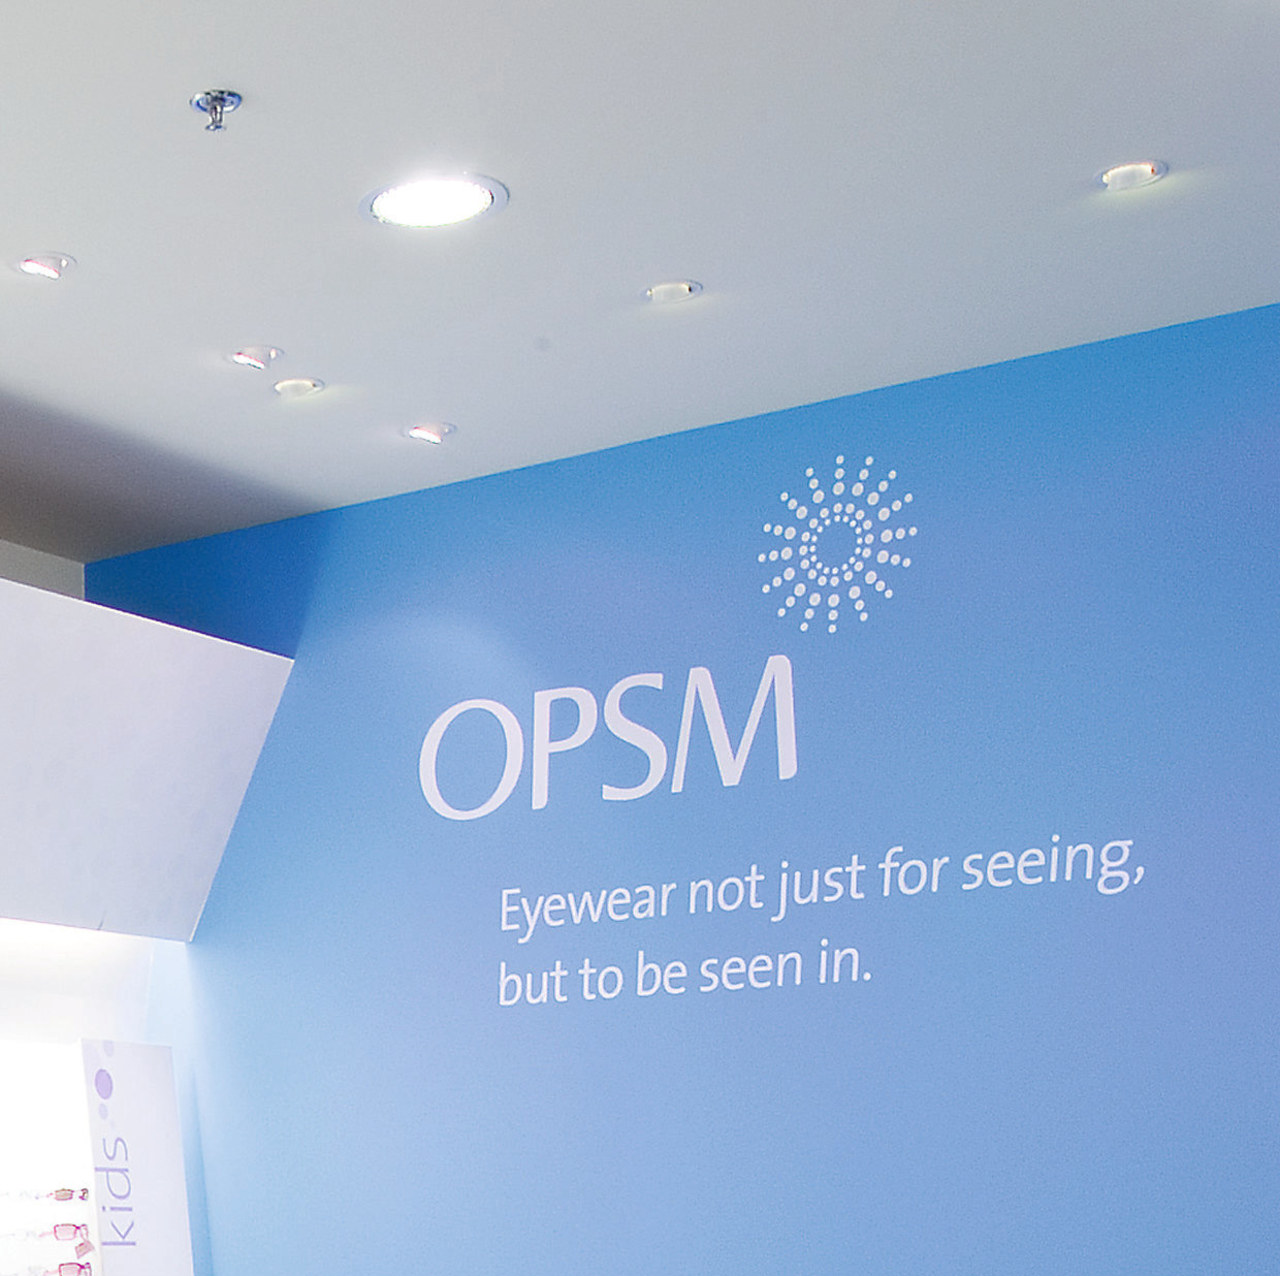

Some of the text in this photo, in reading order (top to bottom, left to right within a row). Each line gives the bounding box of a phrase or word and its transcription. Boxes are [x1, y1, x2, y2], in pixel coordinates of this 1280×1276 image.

[419, 654, 798, 821] OPSM
[500, 834, 1146, 944] Eyewear not just for seeing,
[498, 938, 872, 1006] but to be seen in.
[94, 1136, 137, 1247] kids
